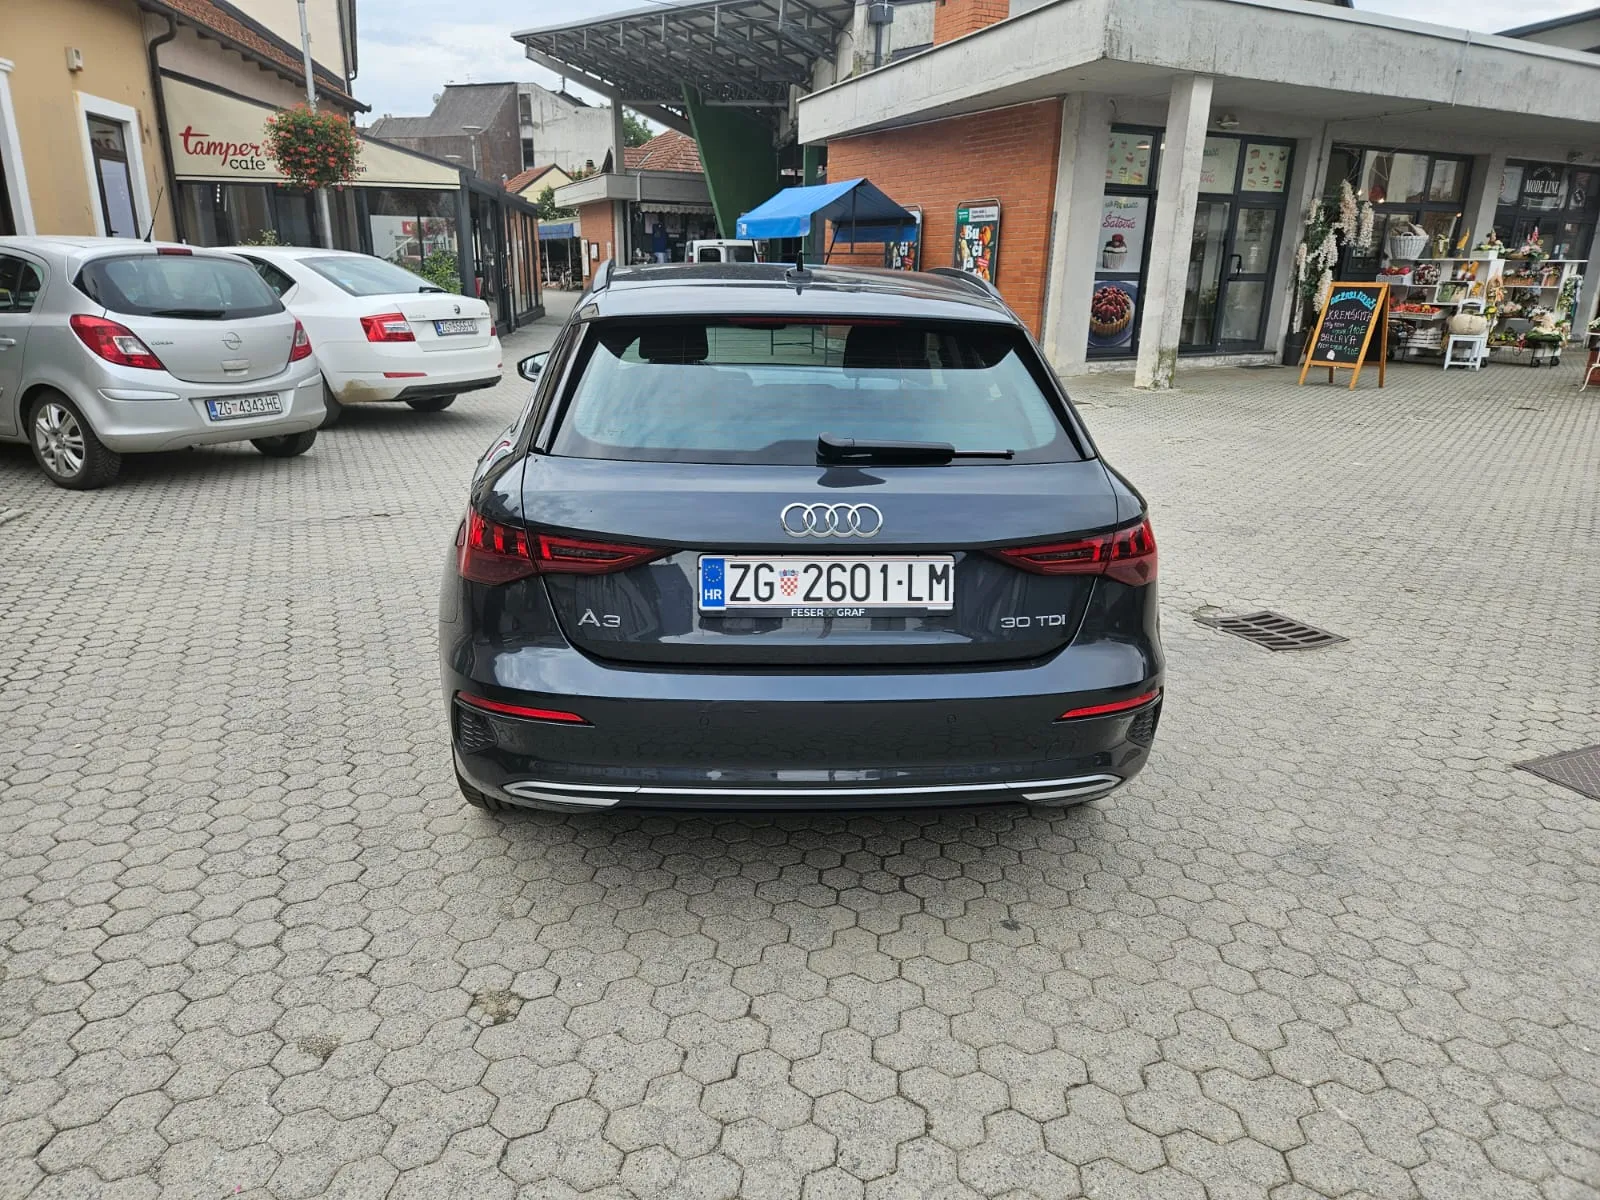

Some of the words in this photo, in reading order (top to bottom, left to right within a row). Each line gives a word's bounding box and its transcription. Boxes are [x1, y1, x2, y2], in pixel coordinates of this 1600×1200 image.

[179, 125, 262, 167] tamper
[229, 155, 266, 171] cafe
[1524, 179, 1545, 193] MODE
[1544, 180, 1561, 194] LINE
[216, 401, 232, 416] ZG
[704, 589, 723, 600] HR
[729, 563, 775, 602] ZG
[577, 608, 621, 628] A3
[791, 608, 824, 617] FESER
[836, 608, 865, 617] GRAF
[1000, 616, 1031, 629] 30
[1035, 614, 1066, 627] TDI
